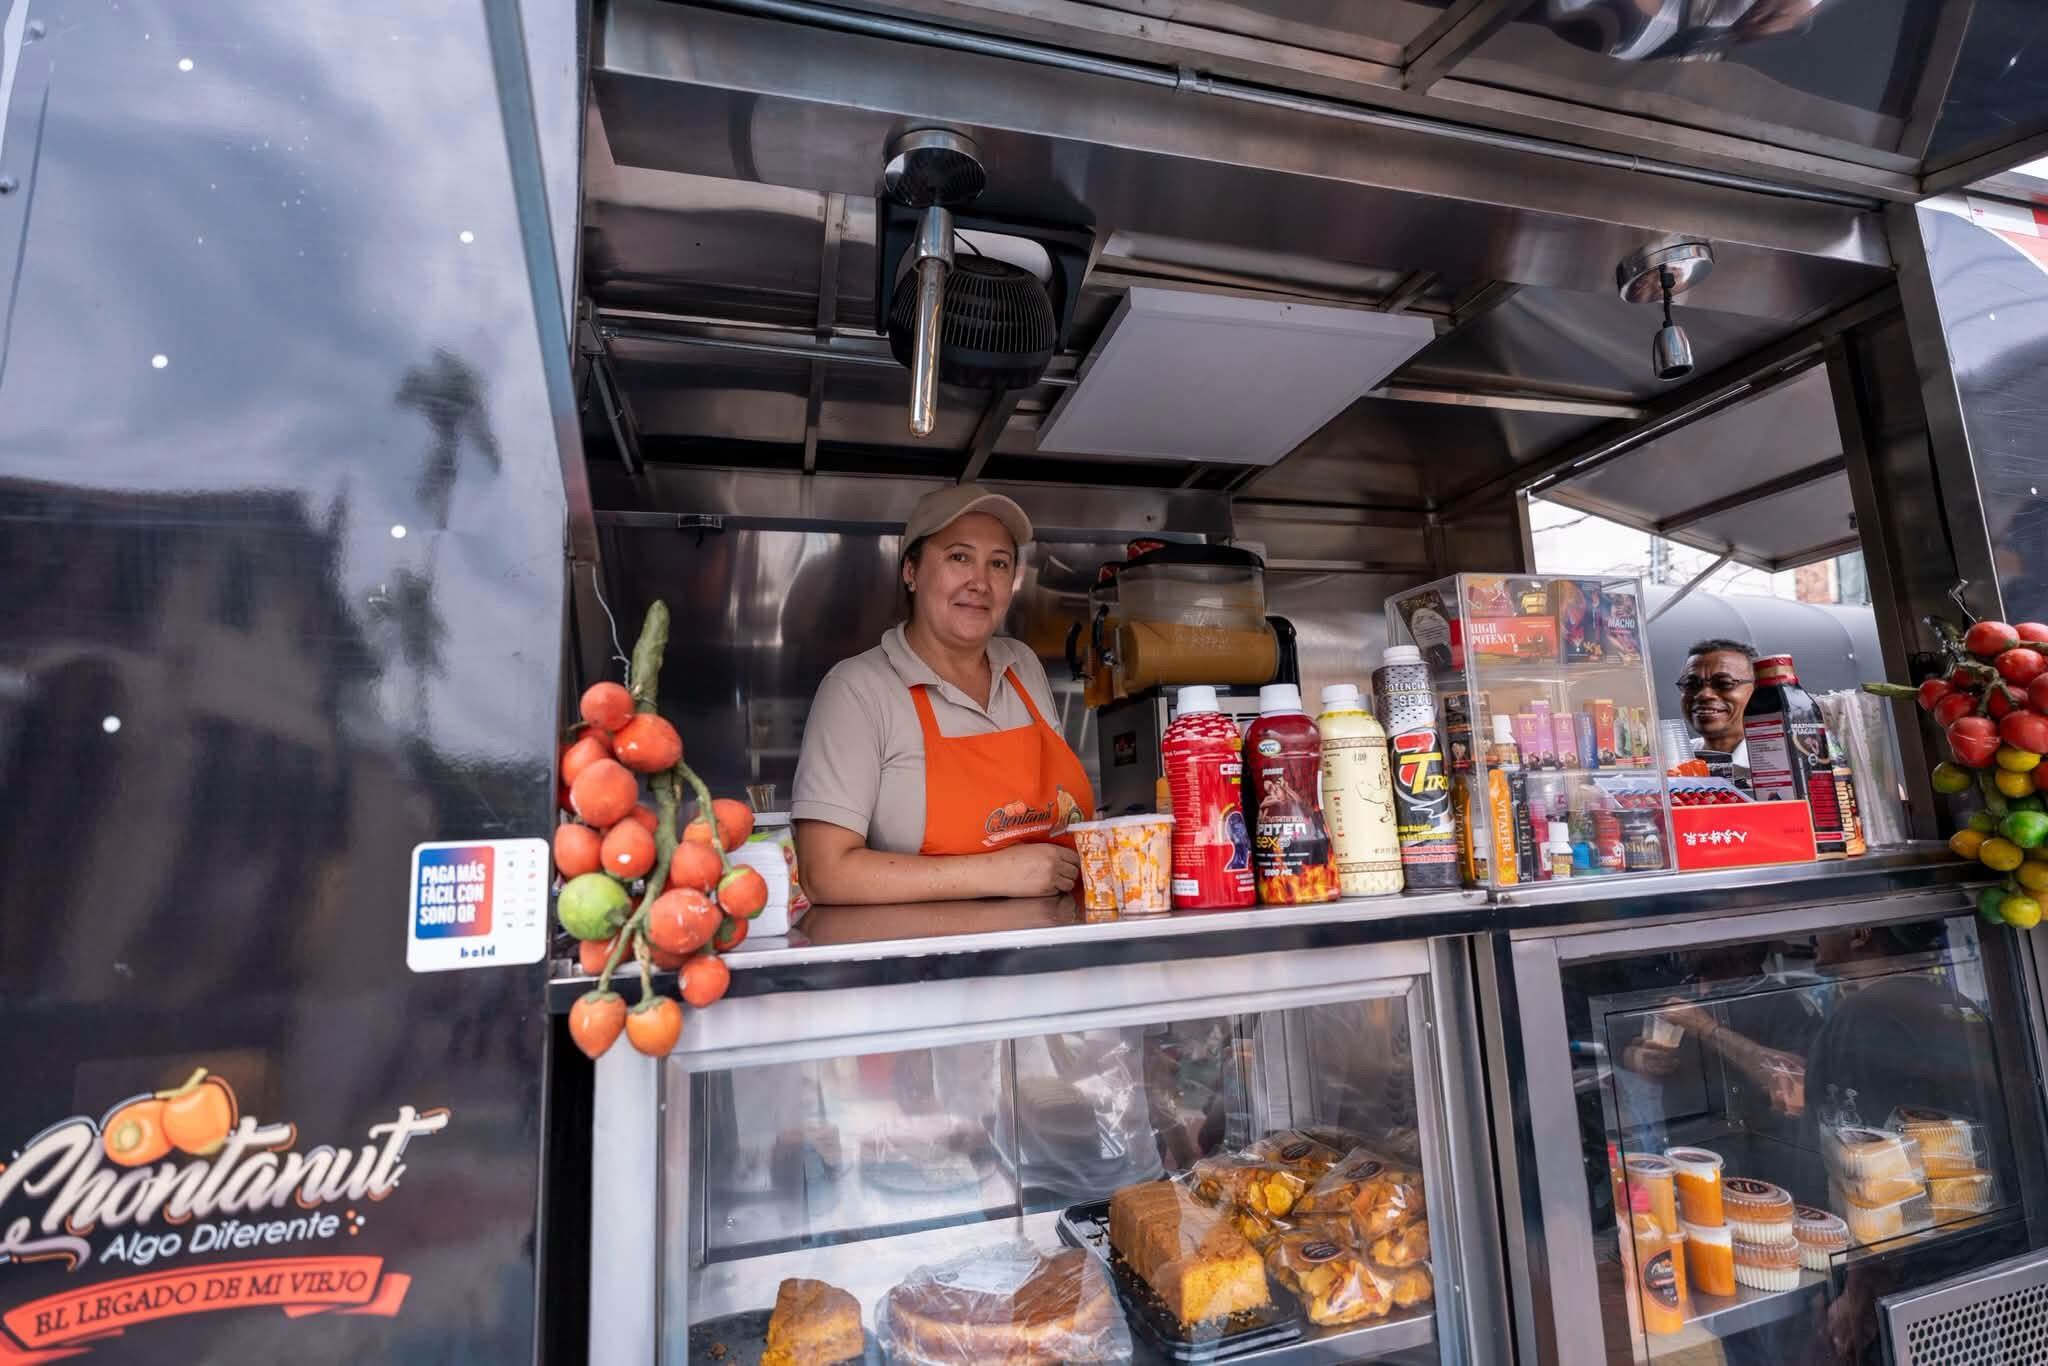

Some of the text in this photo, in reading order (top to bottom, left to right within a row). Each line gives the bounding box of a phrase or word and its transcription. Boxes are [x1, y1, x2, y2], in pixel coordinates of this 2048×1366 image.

[1471, 632, 1517, 645] POTENCY
[421, 860, 486, 885] PAGA MÁS
[420, 883, 485, 905] FÁCIL CON
[460, 944, 496, 959] bold
[0, 1104, 450, 1270] Chontanut
[100, 1210, 340, 1266] Algo Diferente
[34, 1268, 369, 1338] EL LEGADO DE MI VIEJO
